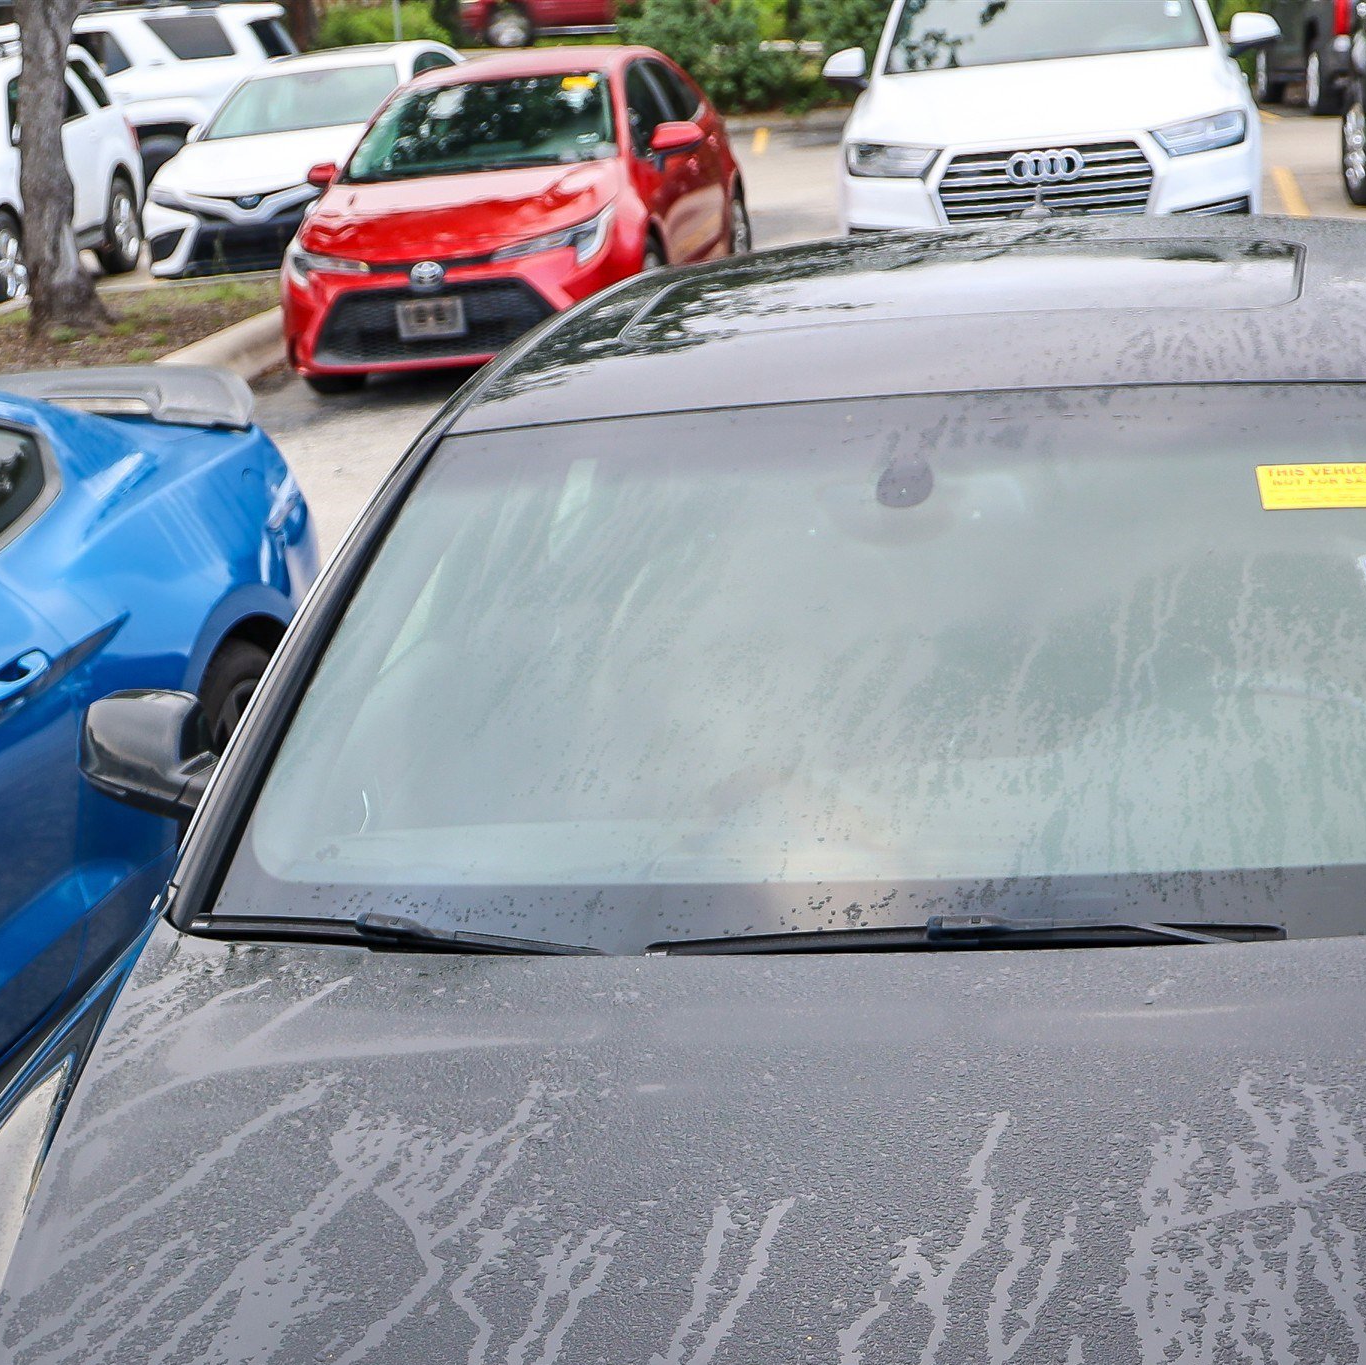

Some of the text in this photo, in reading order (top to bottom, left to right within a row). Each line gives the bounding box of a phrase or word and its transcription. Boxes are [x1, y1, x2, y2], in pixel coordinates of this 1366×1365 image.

[1267, 466, 1305, 477] THIS
[1272, 478, 1301, 486] NOT
[1308, 477, 1338, 485] FOR
